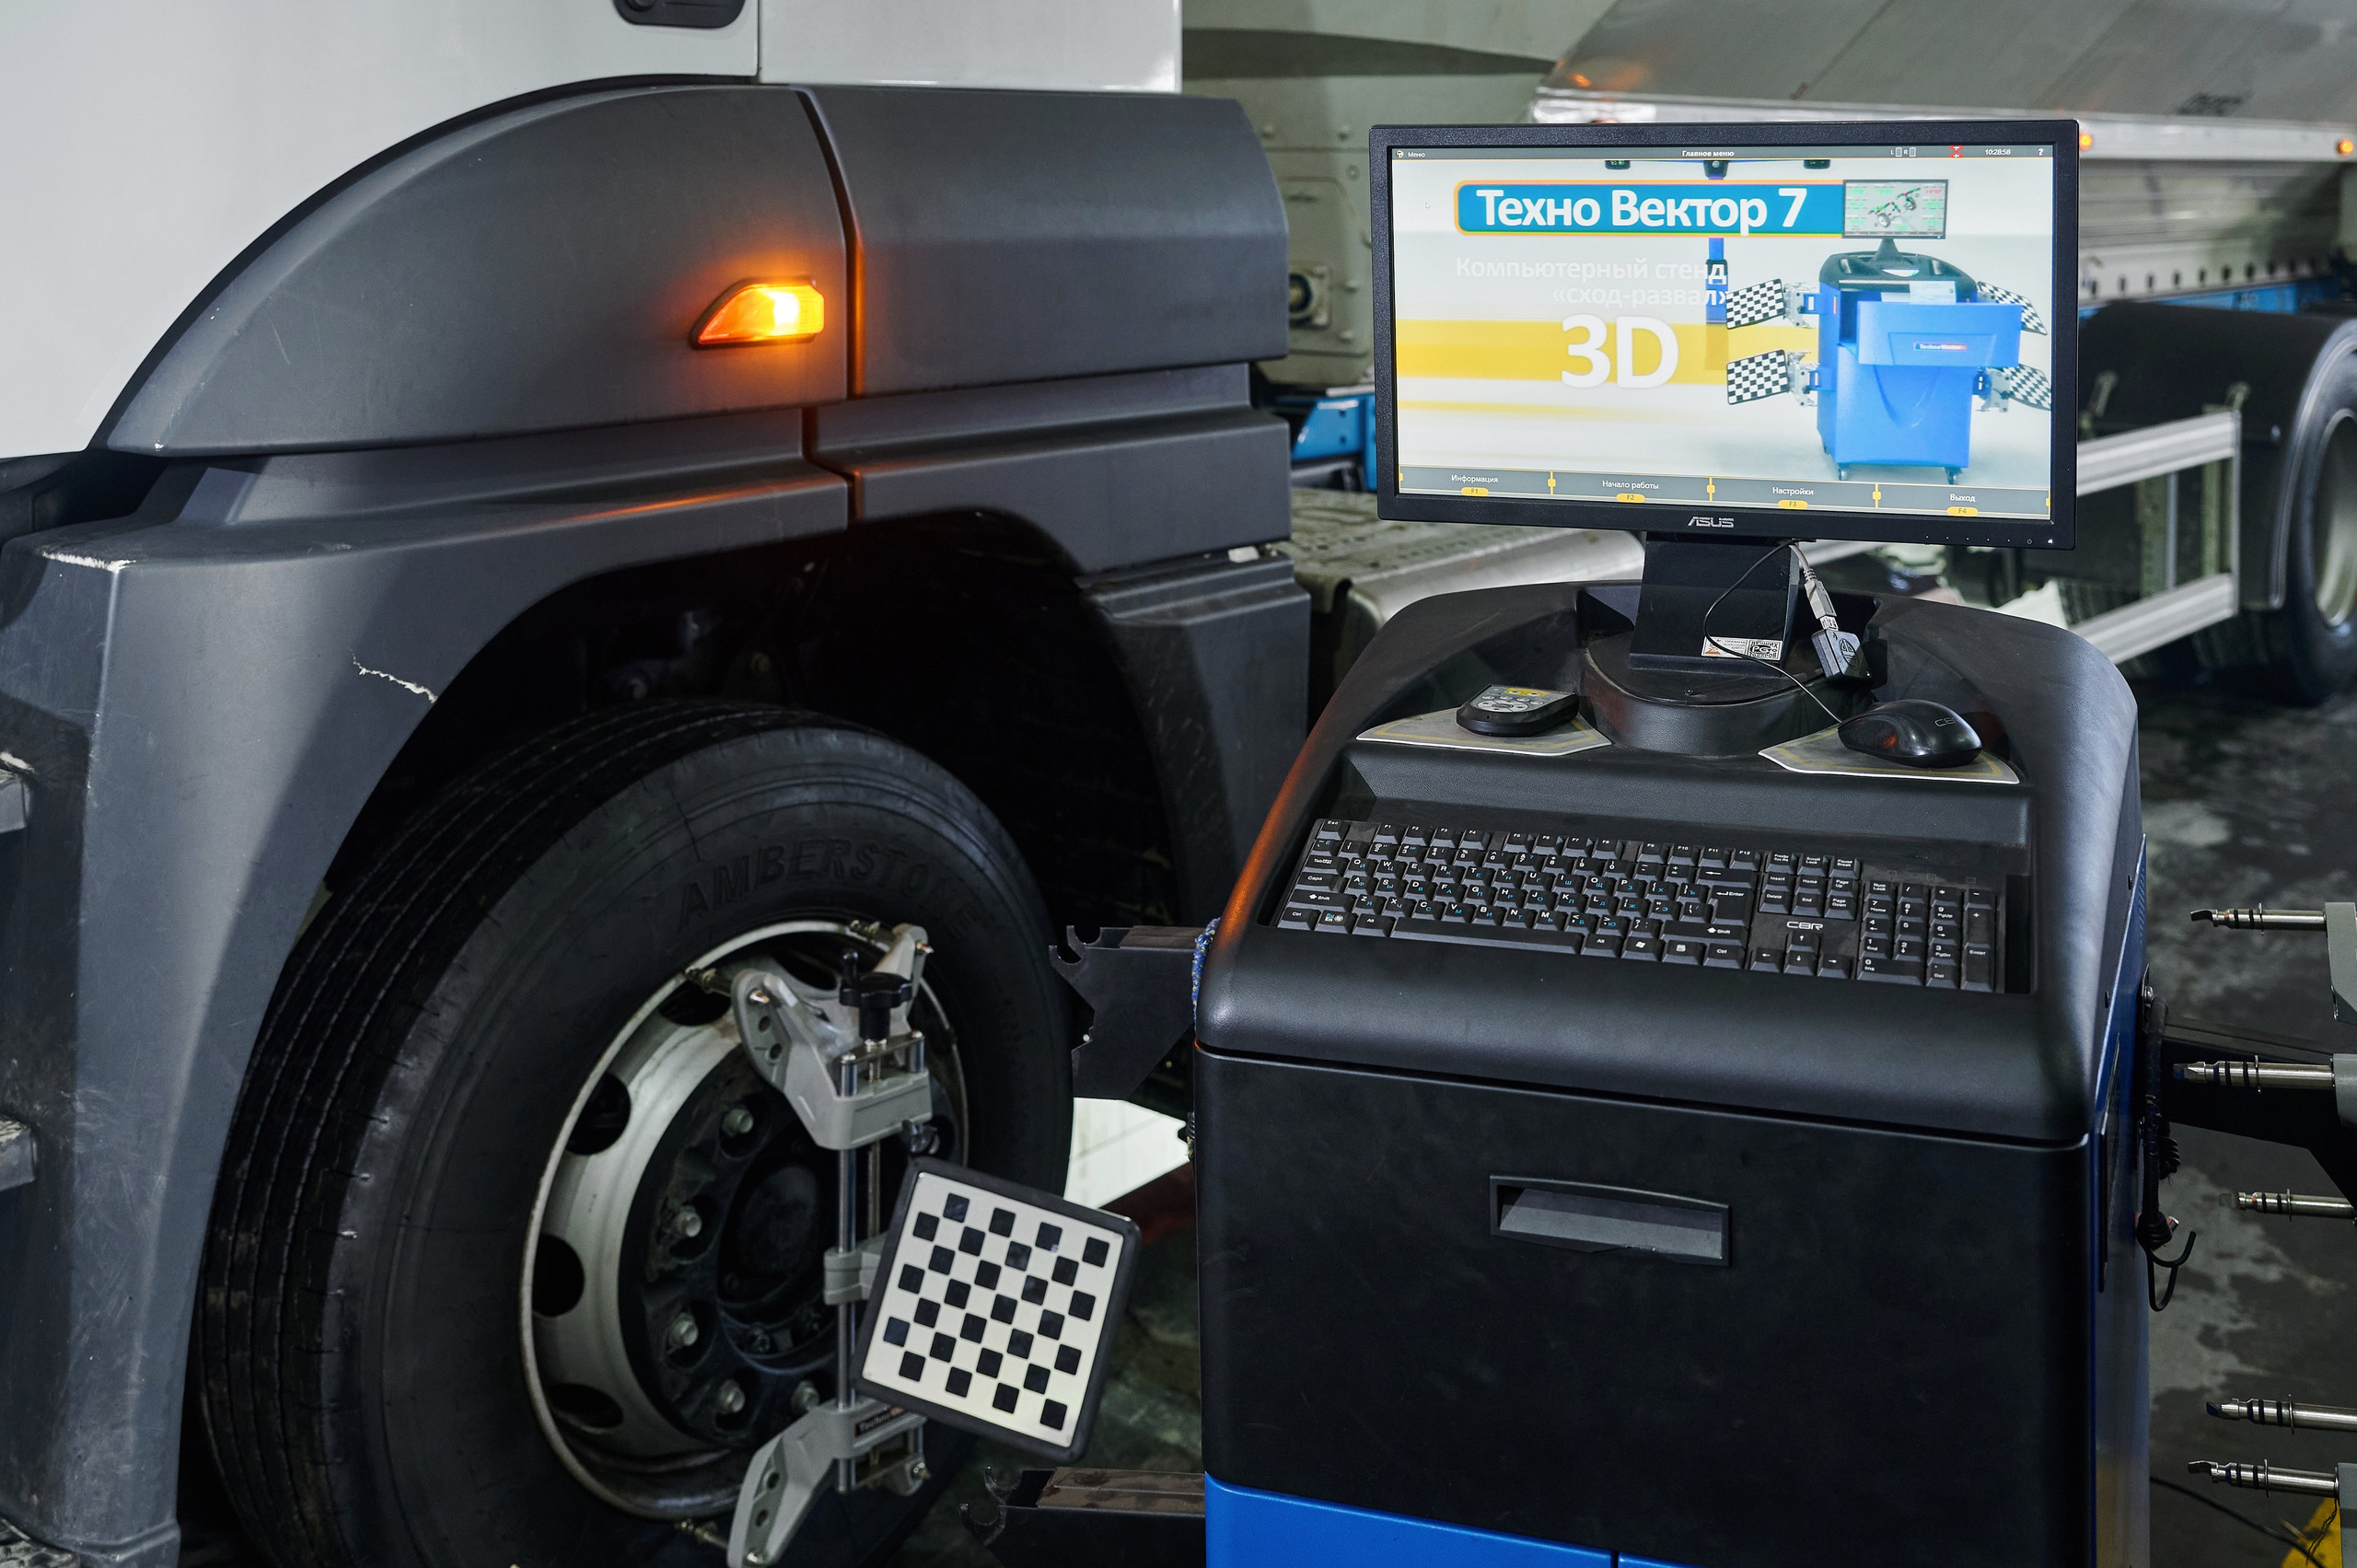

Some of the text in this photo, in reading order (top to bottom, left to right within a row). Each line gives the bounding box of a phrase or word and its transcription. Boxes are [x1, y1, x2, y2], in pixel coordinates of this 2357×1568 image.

[1682, 149, 1712, 157] Главное
[1476, 187, 1807, 236] Техно Вектор 7
[1457, 257, 1726, 285] Компьютерный стенд
[1552, 285, 1730, 308] «сход-развал»
[1561, 314, 1679, 389] 3D
[1451, 474, 1499, 484] Информация
[1602, 480, 1659, 492] Начало работы
[1771, 485, 1814, 497] Настройки
[1949, 494, 1976, 504] Выход
[1687, 517, 1735, 528] ASUS
[1786, 921, 1823, 930] CBR
